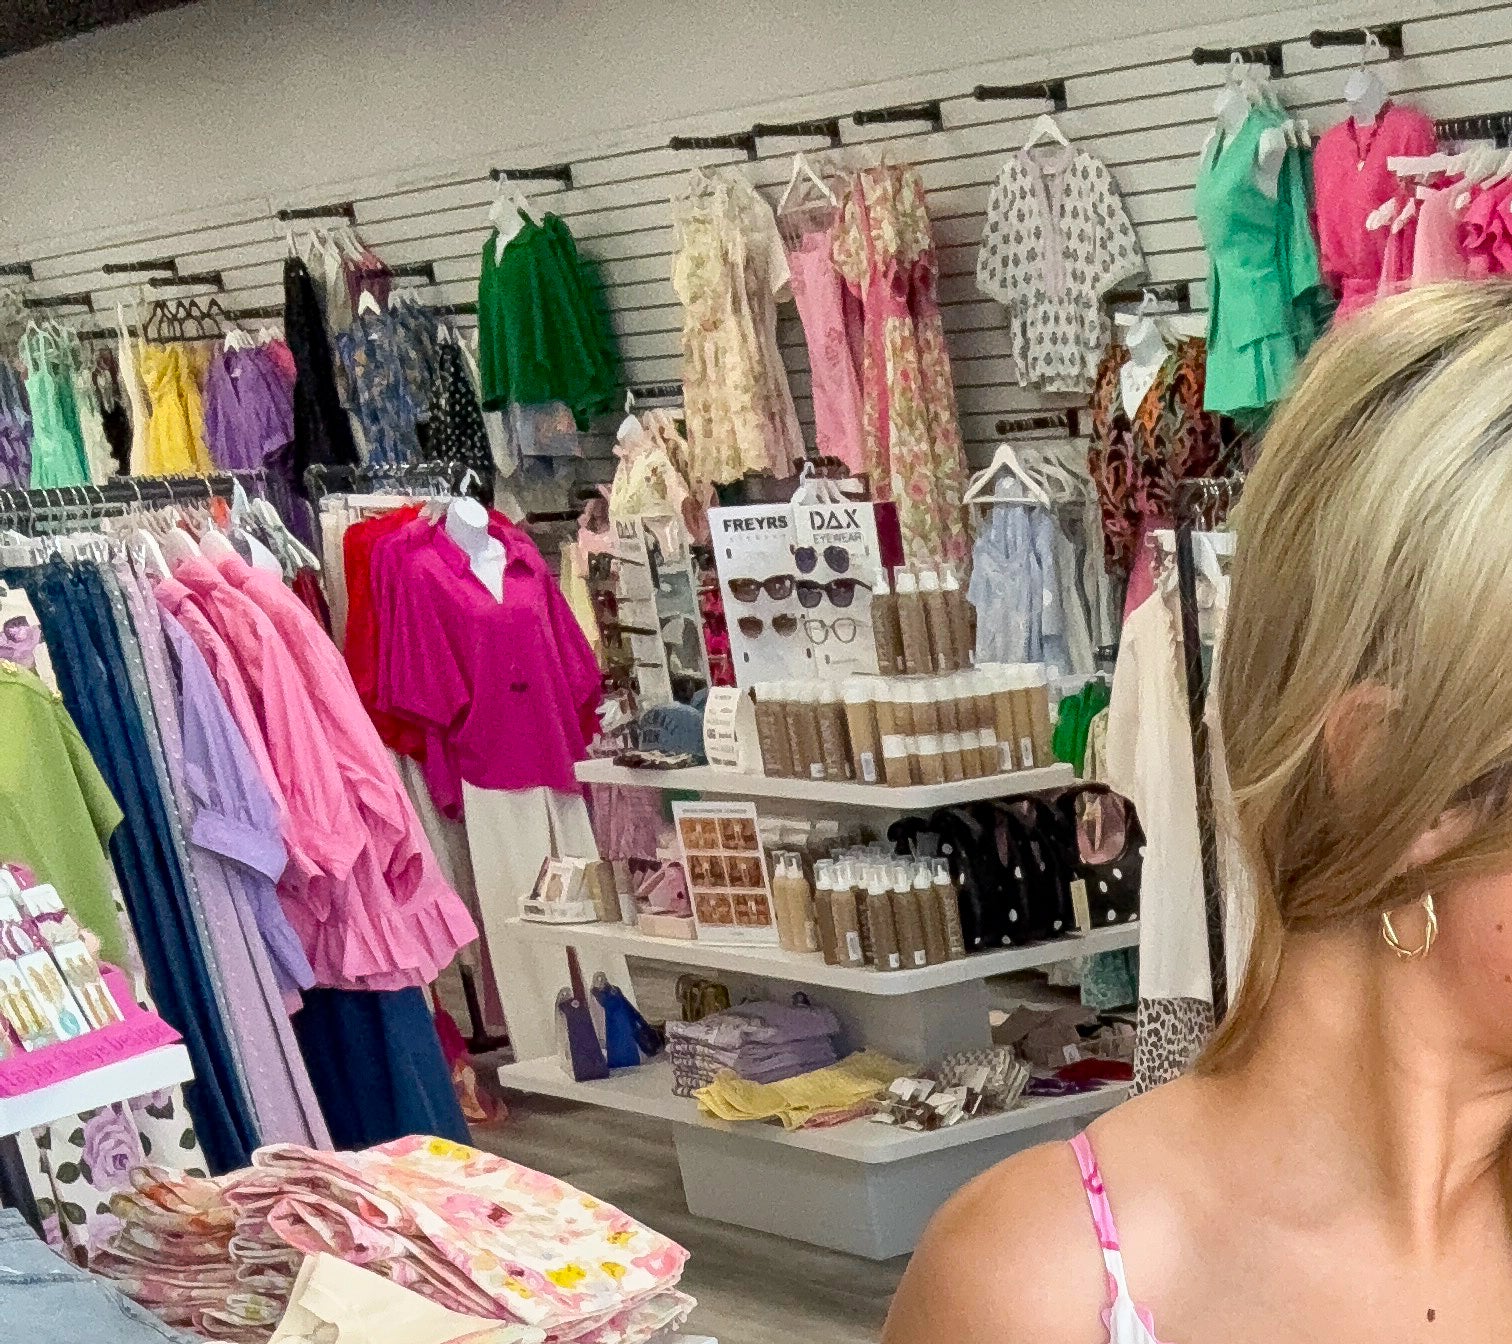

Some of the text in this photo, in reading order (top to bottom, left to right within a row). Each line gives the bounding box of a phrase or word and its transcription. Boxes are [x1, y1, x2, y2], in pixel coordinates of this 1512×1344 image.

[722, 515, 789, 533] FREYRS
[809, 508, 861, 531] DAX
[813, 531, 864, 545] EYEWEAR
